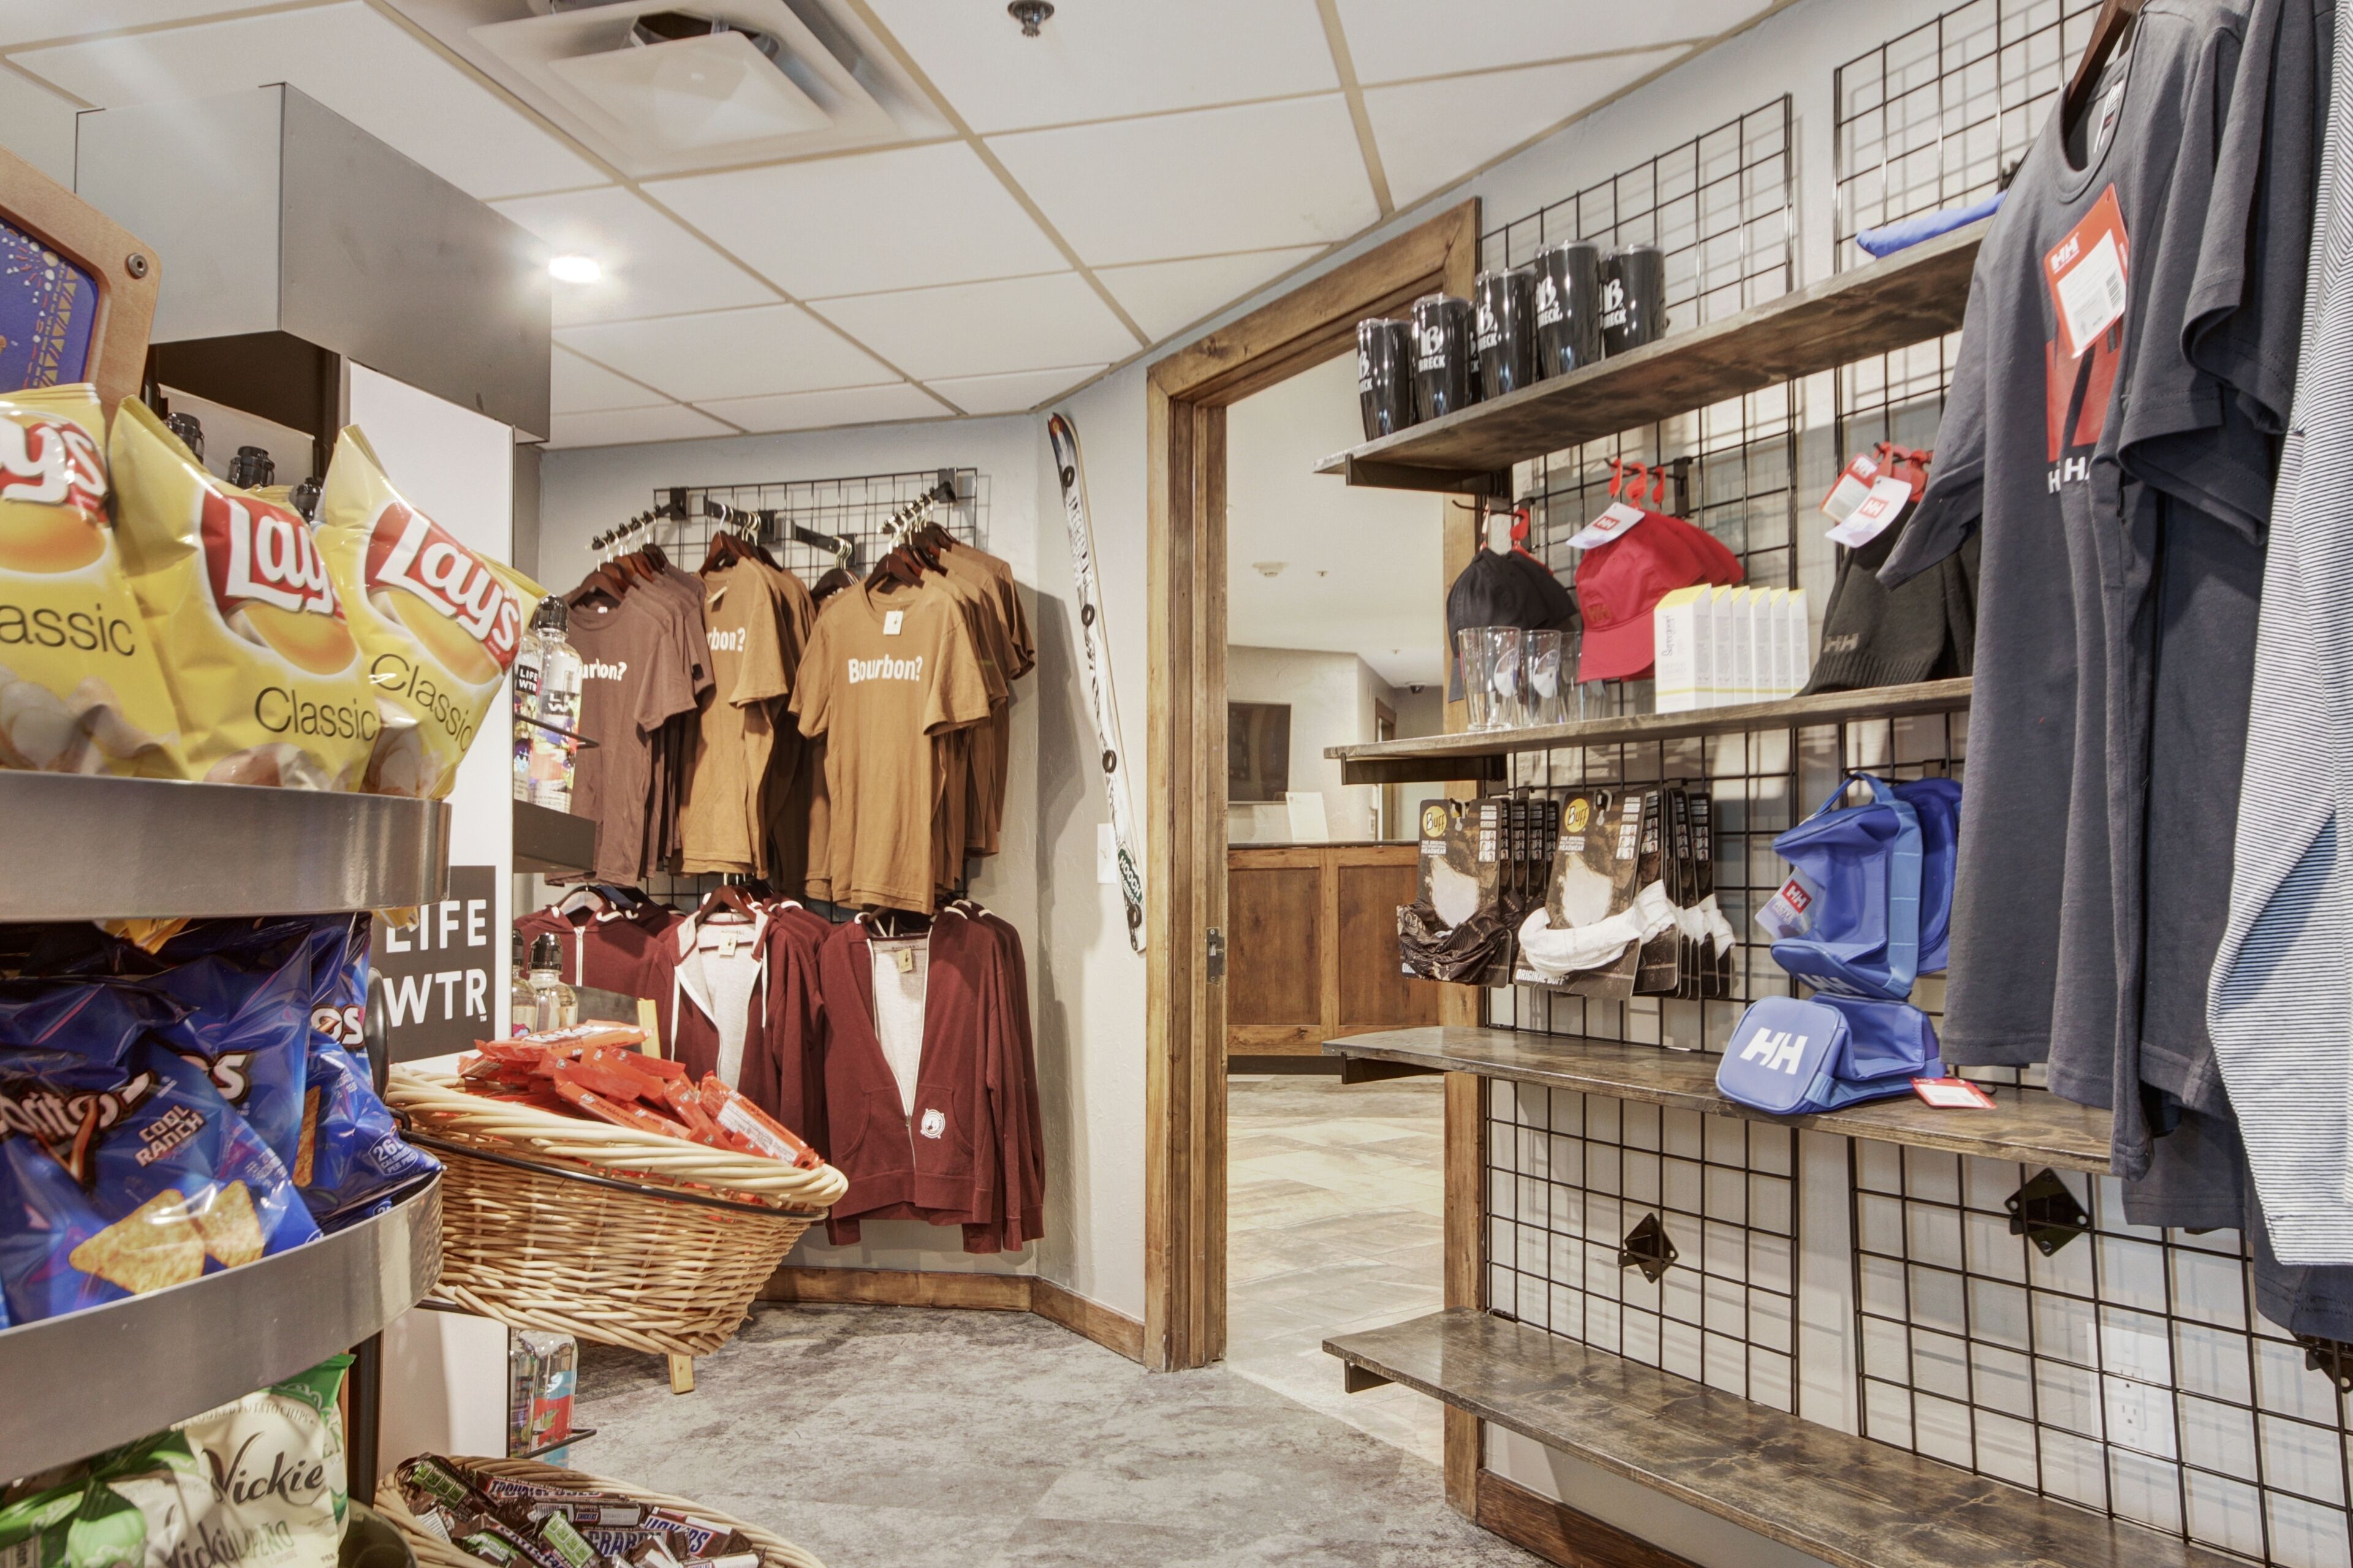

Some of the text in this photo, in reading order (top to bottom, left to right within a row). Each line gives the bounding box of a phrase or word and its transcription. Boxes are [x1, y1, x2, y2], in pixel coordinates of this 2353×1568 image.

[1419, 355, 1446, 373] BRECK
[225, 498, 342, 614] Lay
[0, 603, 135, 656] assic
[707, 626, 745, 652] rbon?
[1823, 632, 1859, 653] HH
[518, 679, 537, 693] WTR
[519, 668, 538, 682] LIFE
[848, 653, 923, 684] Bourbon?
[254, 687, 376, 741] Classic
[371, 653, 473, 752] Classic
[548, 692, 569, 703] LI
[1120, 855, 1142, 897] HOOCH
[1786, 885, 1808, 908] HH
[386, 900, 487, 953] LIFE
[383, 969, 487, 1028] WTR
[1740, 1027, 1808, 1074] HH
[134, 1112, 205, 1167] RANCH
[138, 1105, 189, 1142] COOL
[280, 1405, 308, 1423] CHIPS
